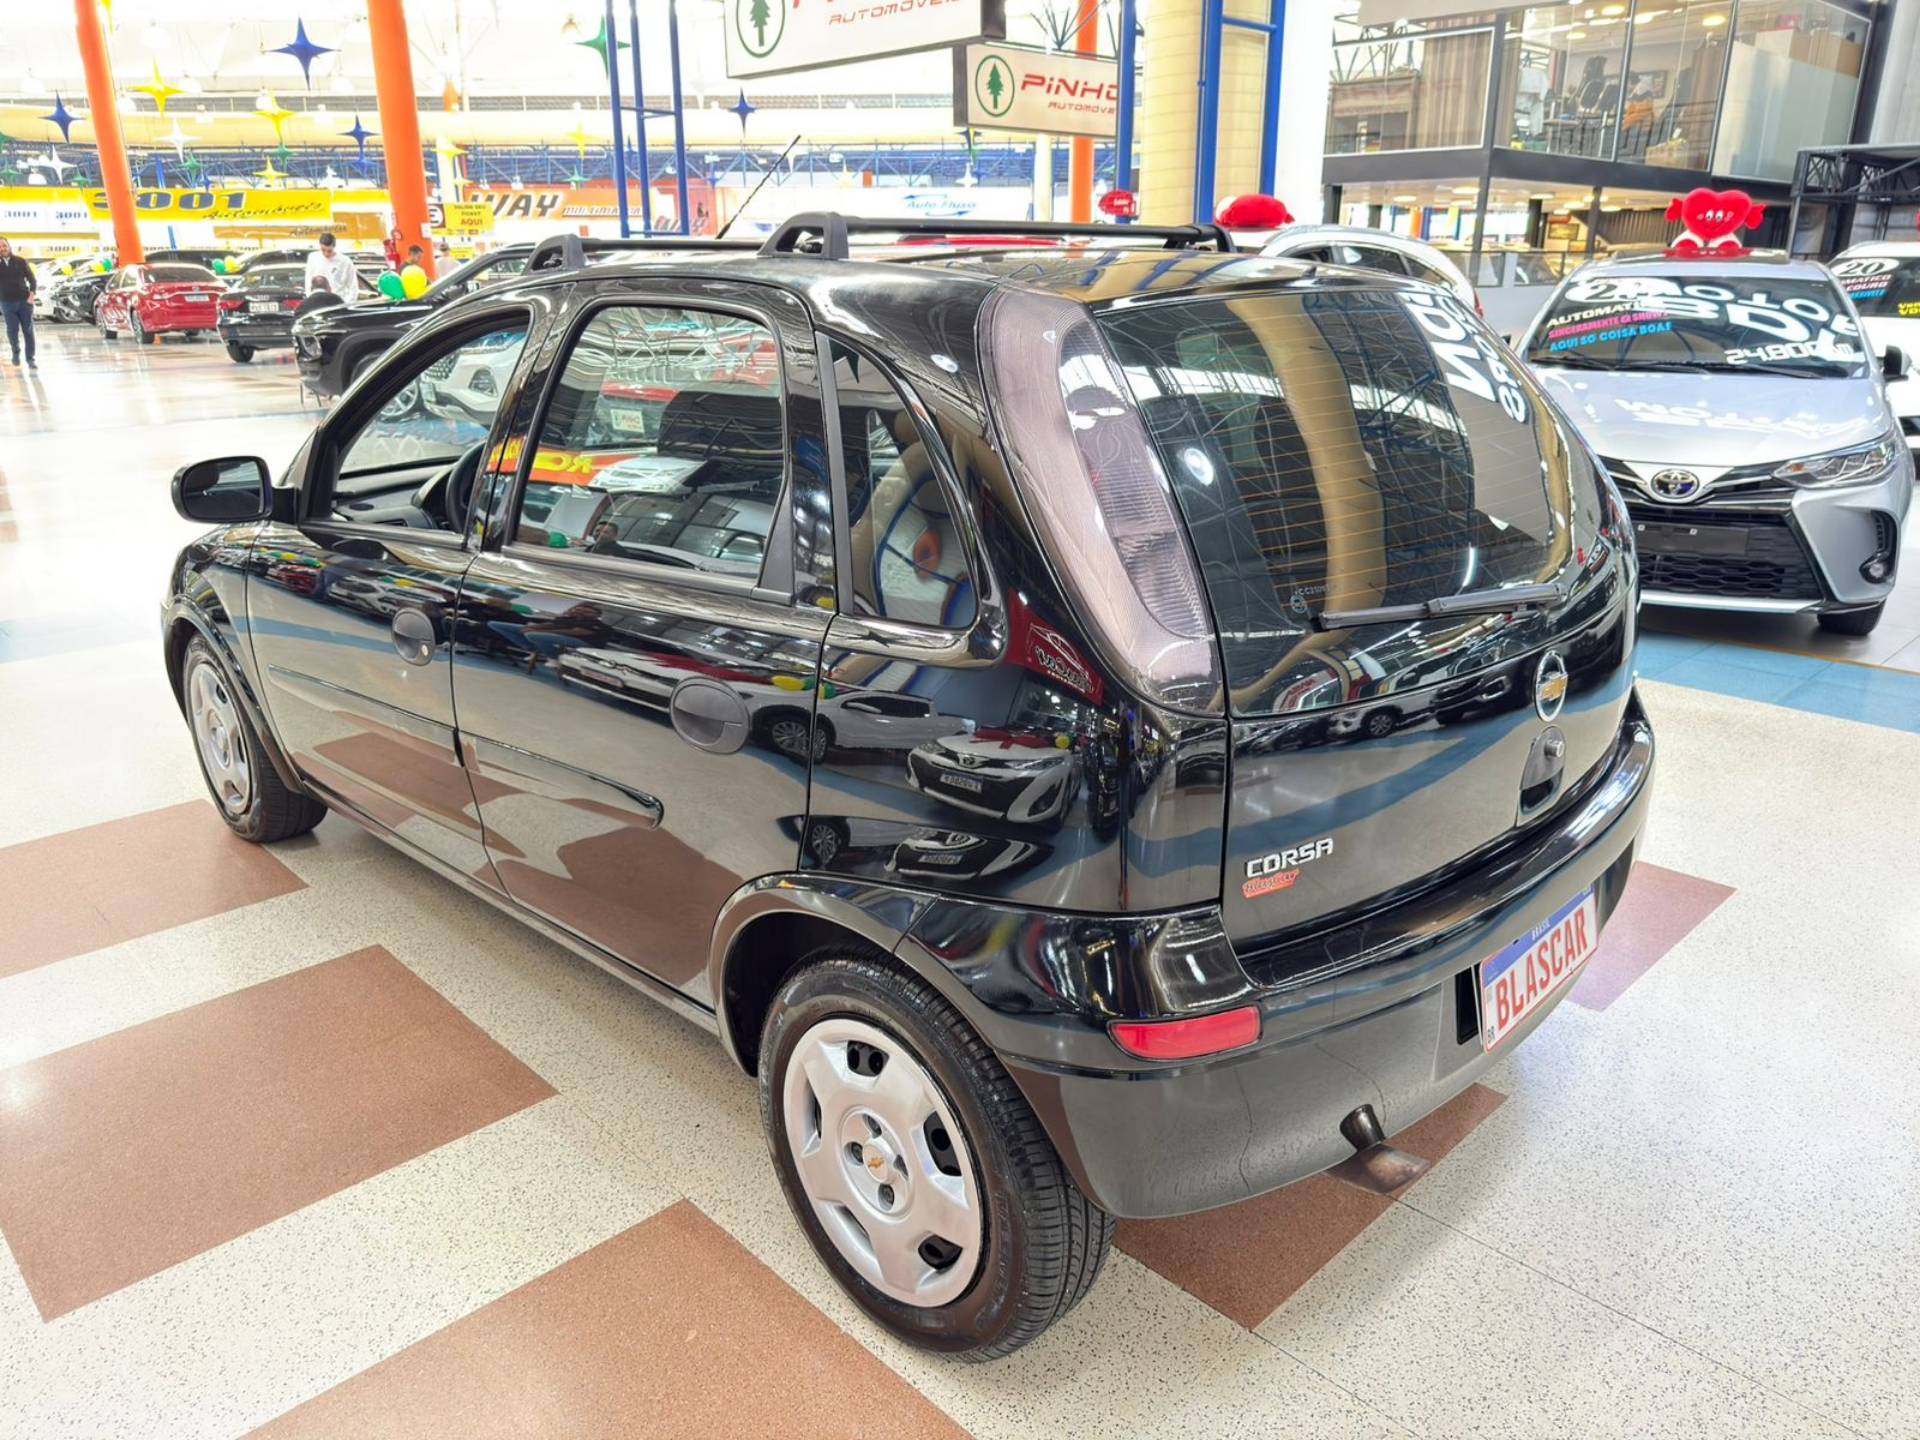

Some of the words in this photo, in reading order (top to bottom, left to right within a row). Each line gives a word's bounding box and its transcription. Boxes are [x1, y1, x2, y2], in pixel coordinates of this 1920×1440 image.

[461, 218, 483, 226] AQUI
[1599, 328, 1637, 343] COISA
[1245, 838, 1334, 879] CORSA
[1495, 906, 1588, 1029] BLASCAR
